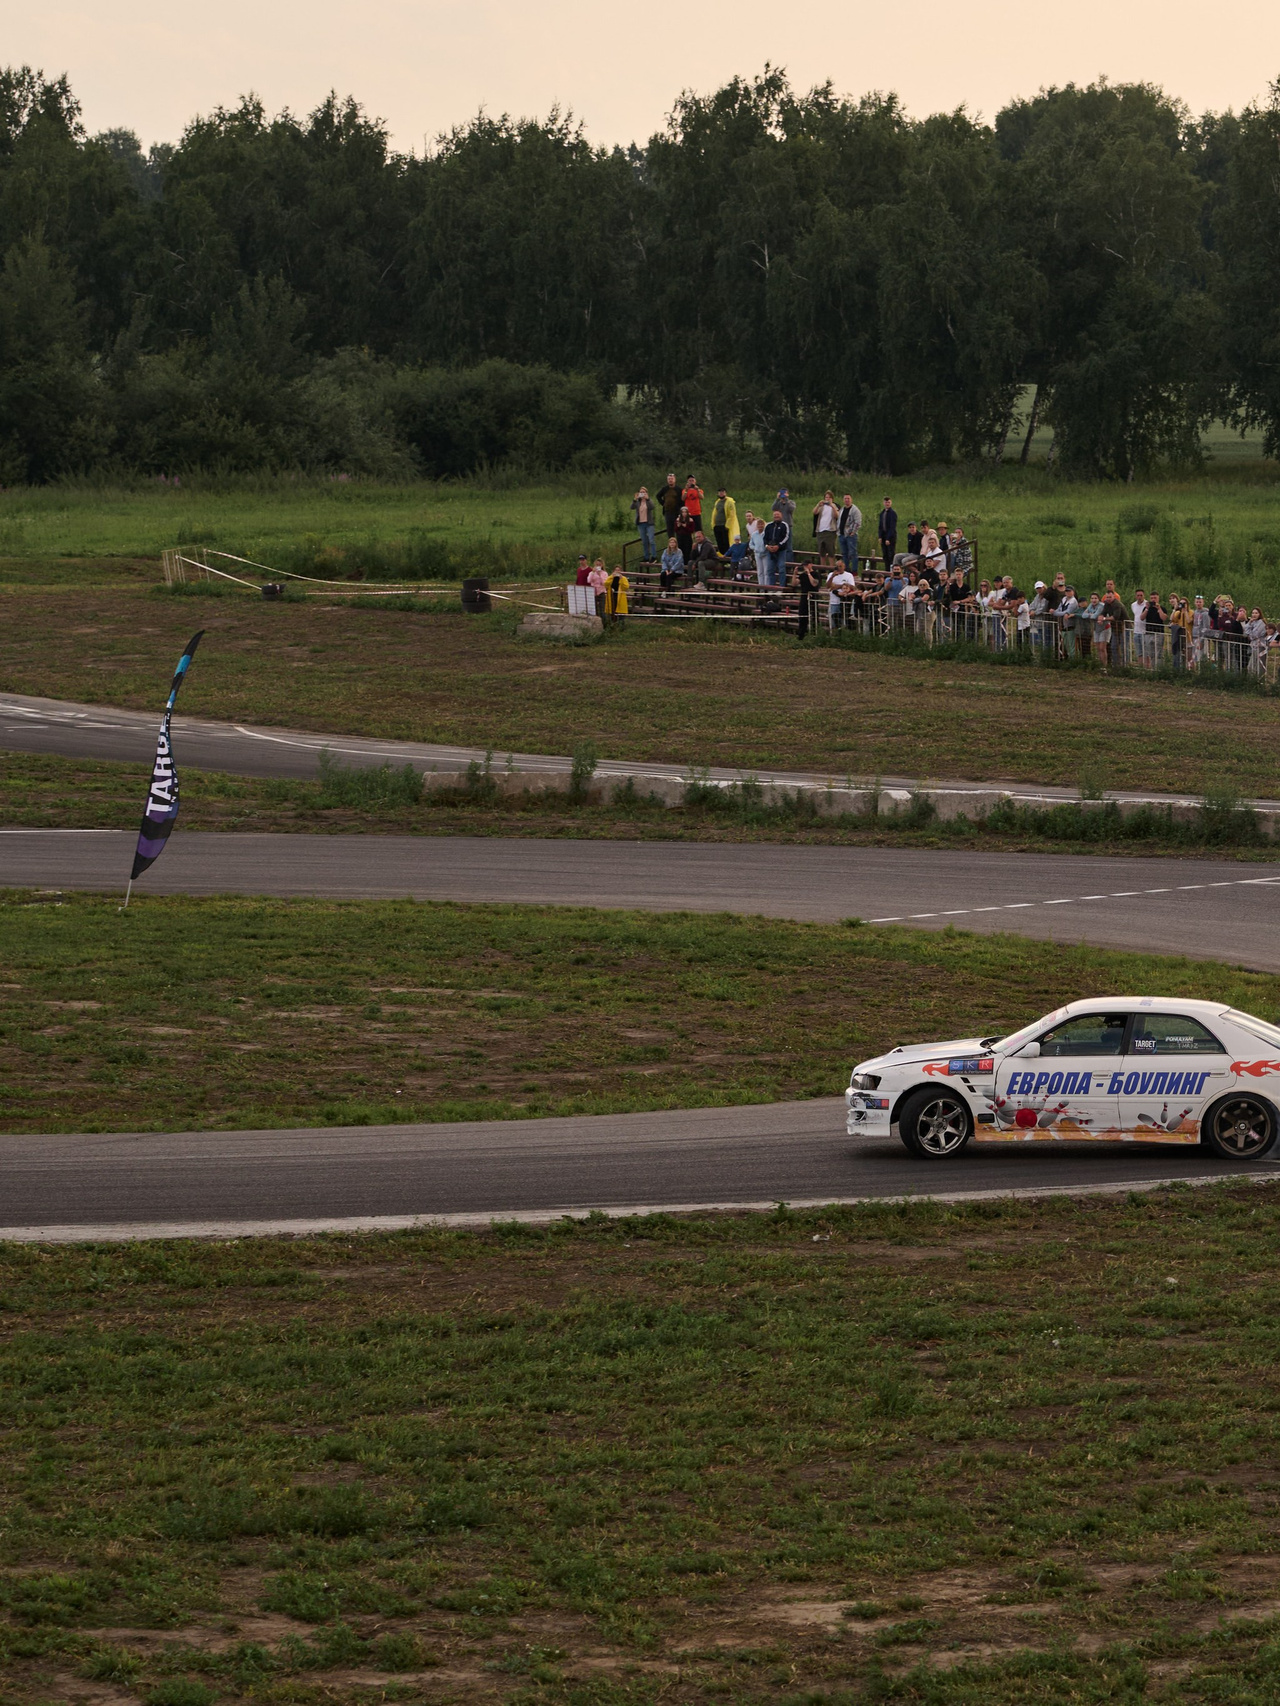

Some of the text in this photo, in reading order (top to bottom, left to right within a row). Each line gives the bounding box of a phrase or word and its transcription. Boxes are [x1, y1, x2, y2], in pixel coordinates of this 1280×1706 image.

[1134, 1040, 1156, 1048] TARGET
[1006, 1072, 1092, 1095] ЕВРОПА
[1107, 1072, 1211, 1095] БОУЛИНГ
